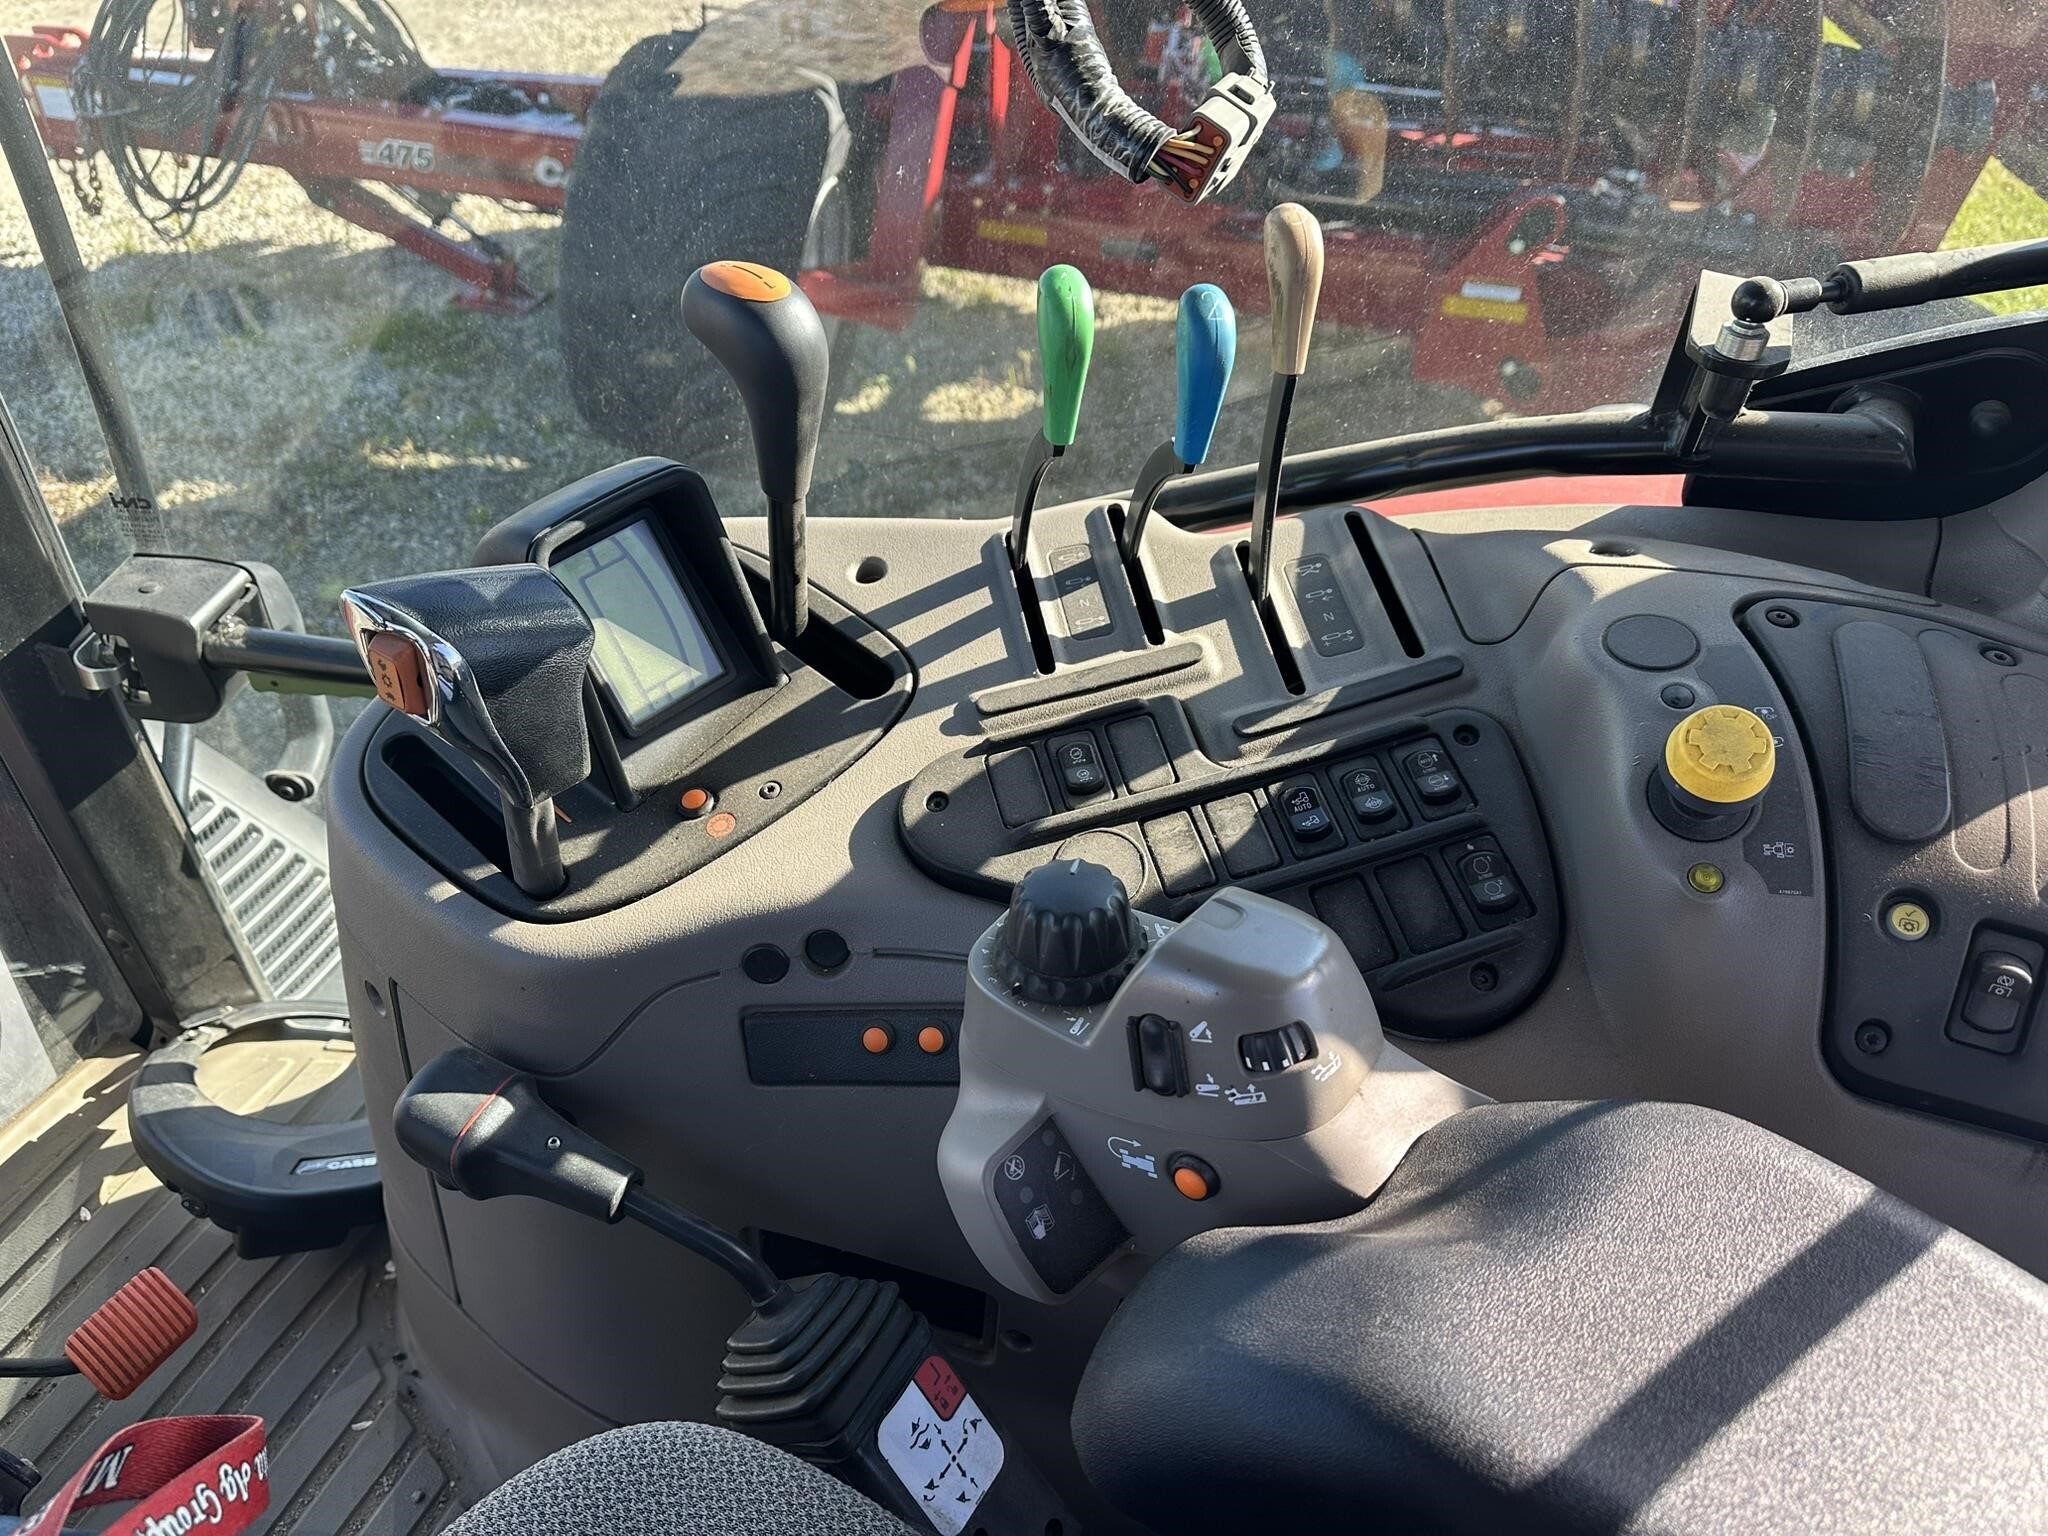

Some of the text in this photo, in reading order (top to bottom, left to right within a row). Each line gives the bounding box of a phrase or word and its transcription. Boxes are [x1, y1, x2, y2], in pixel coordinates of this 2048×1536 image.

[377, 141, 434, 171] 475
[1201, 291, 1224, 320] 2
[1322, 612, 1335, 621] N
[1357, 783, 1375, 792] AUTO
[1294, 802, 1312, 813] AUTO
